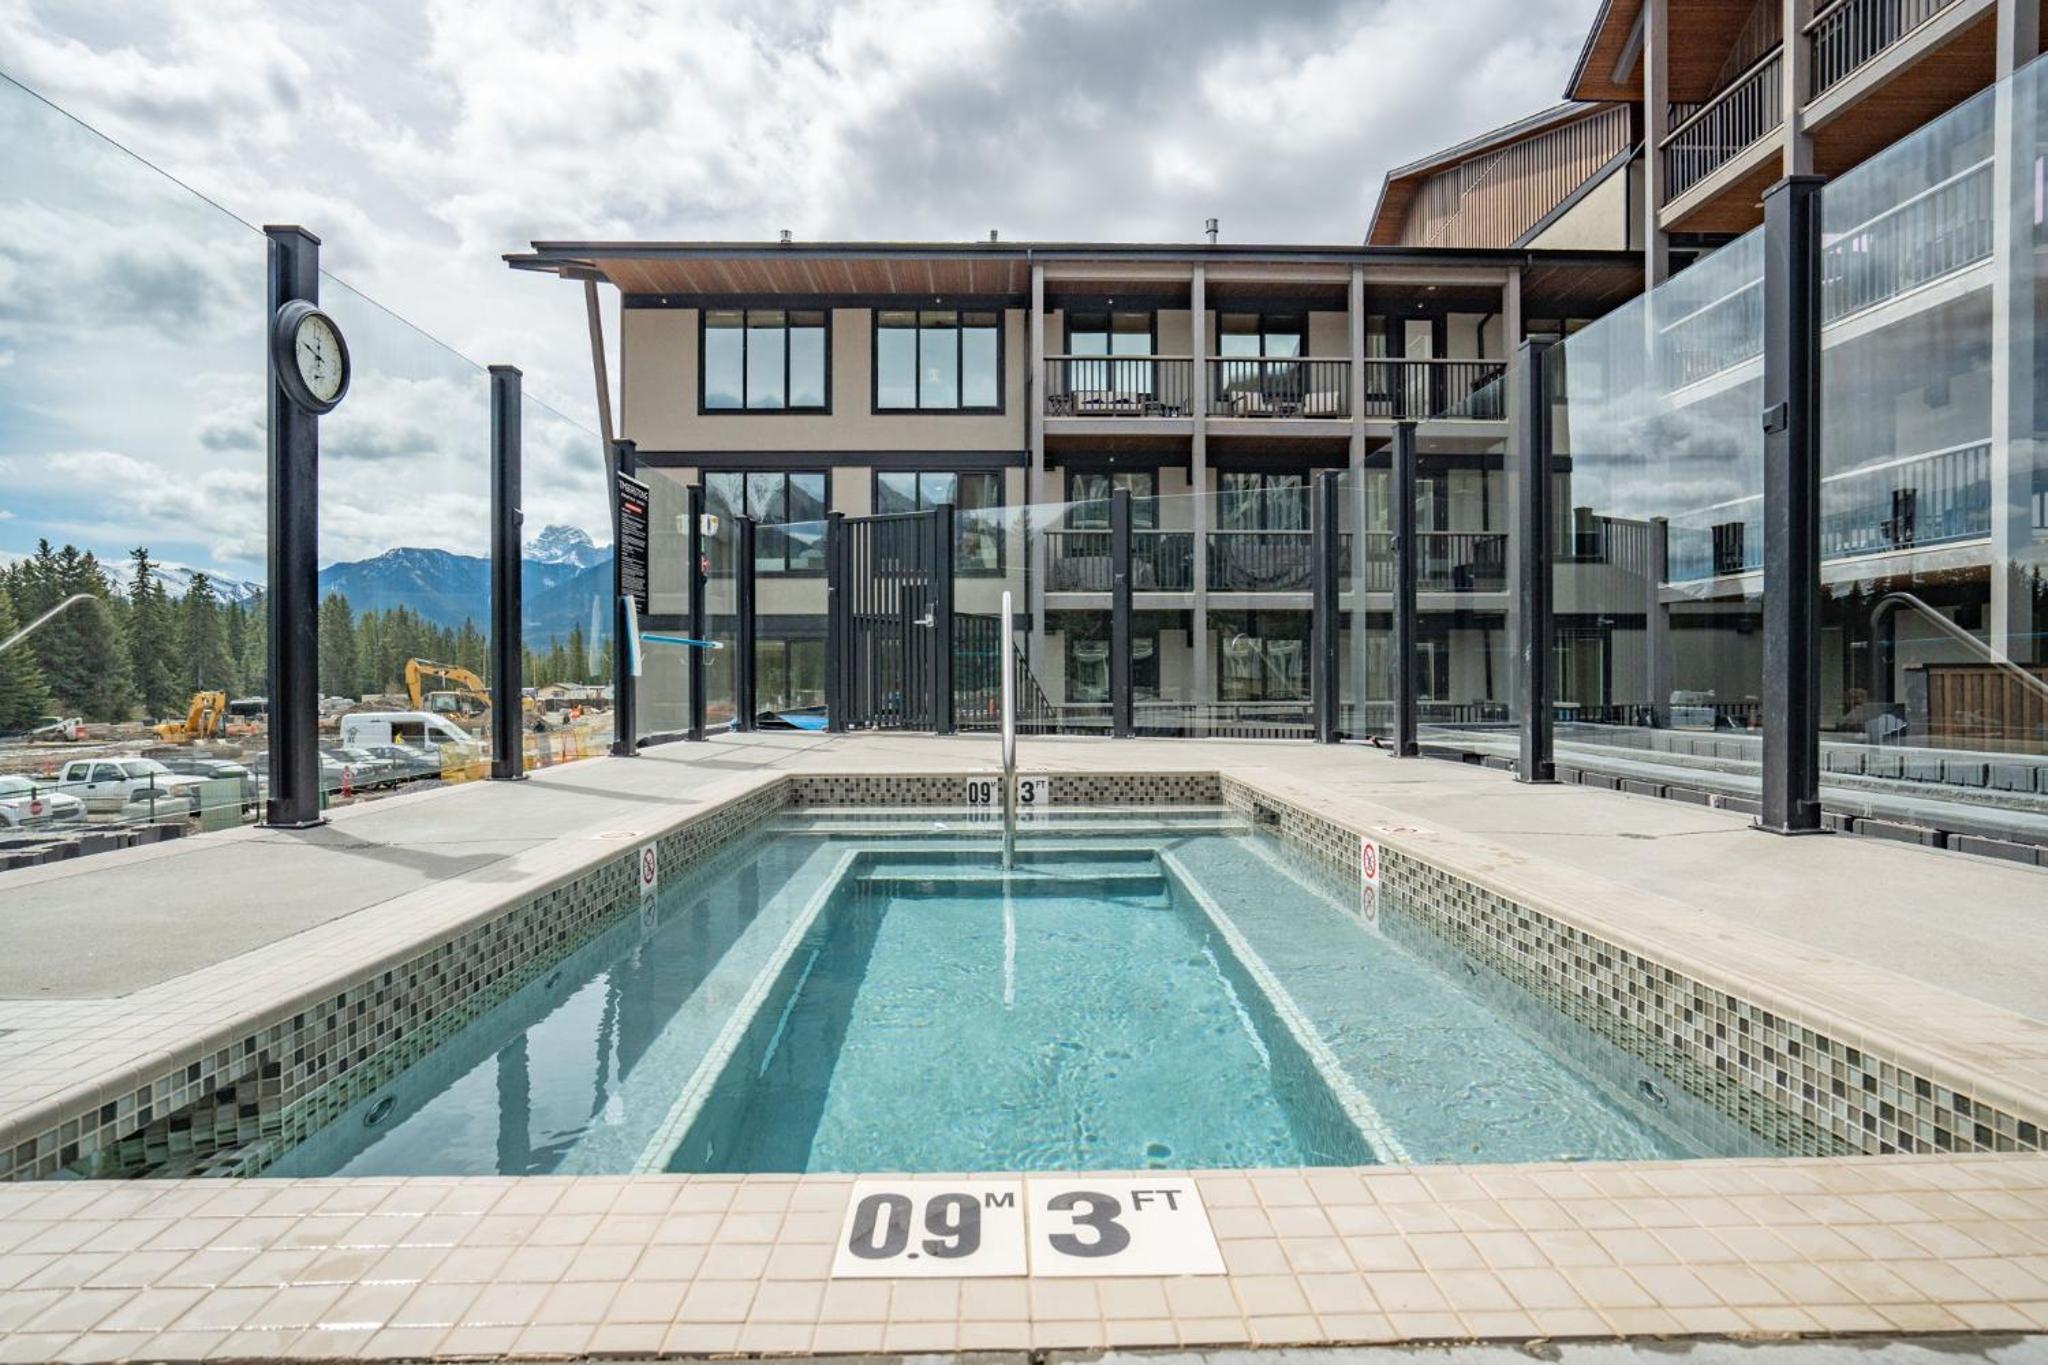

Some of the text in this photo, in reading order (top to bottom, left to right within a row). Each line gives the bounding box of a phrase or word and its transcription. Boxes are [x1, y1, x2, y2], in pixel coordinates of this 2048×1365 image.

[1020, 780, 1046, 803] 3 FT
[849, 1192, 1015, 1260] 0.9 M
[1046, 1189, 1182, 1258] 3 FT
